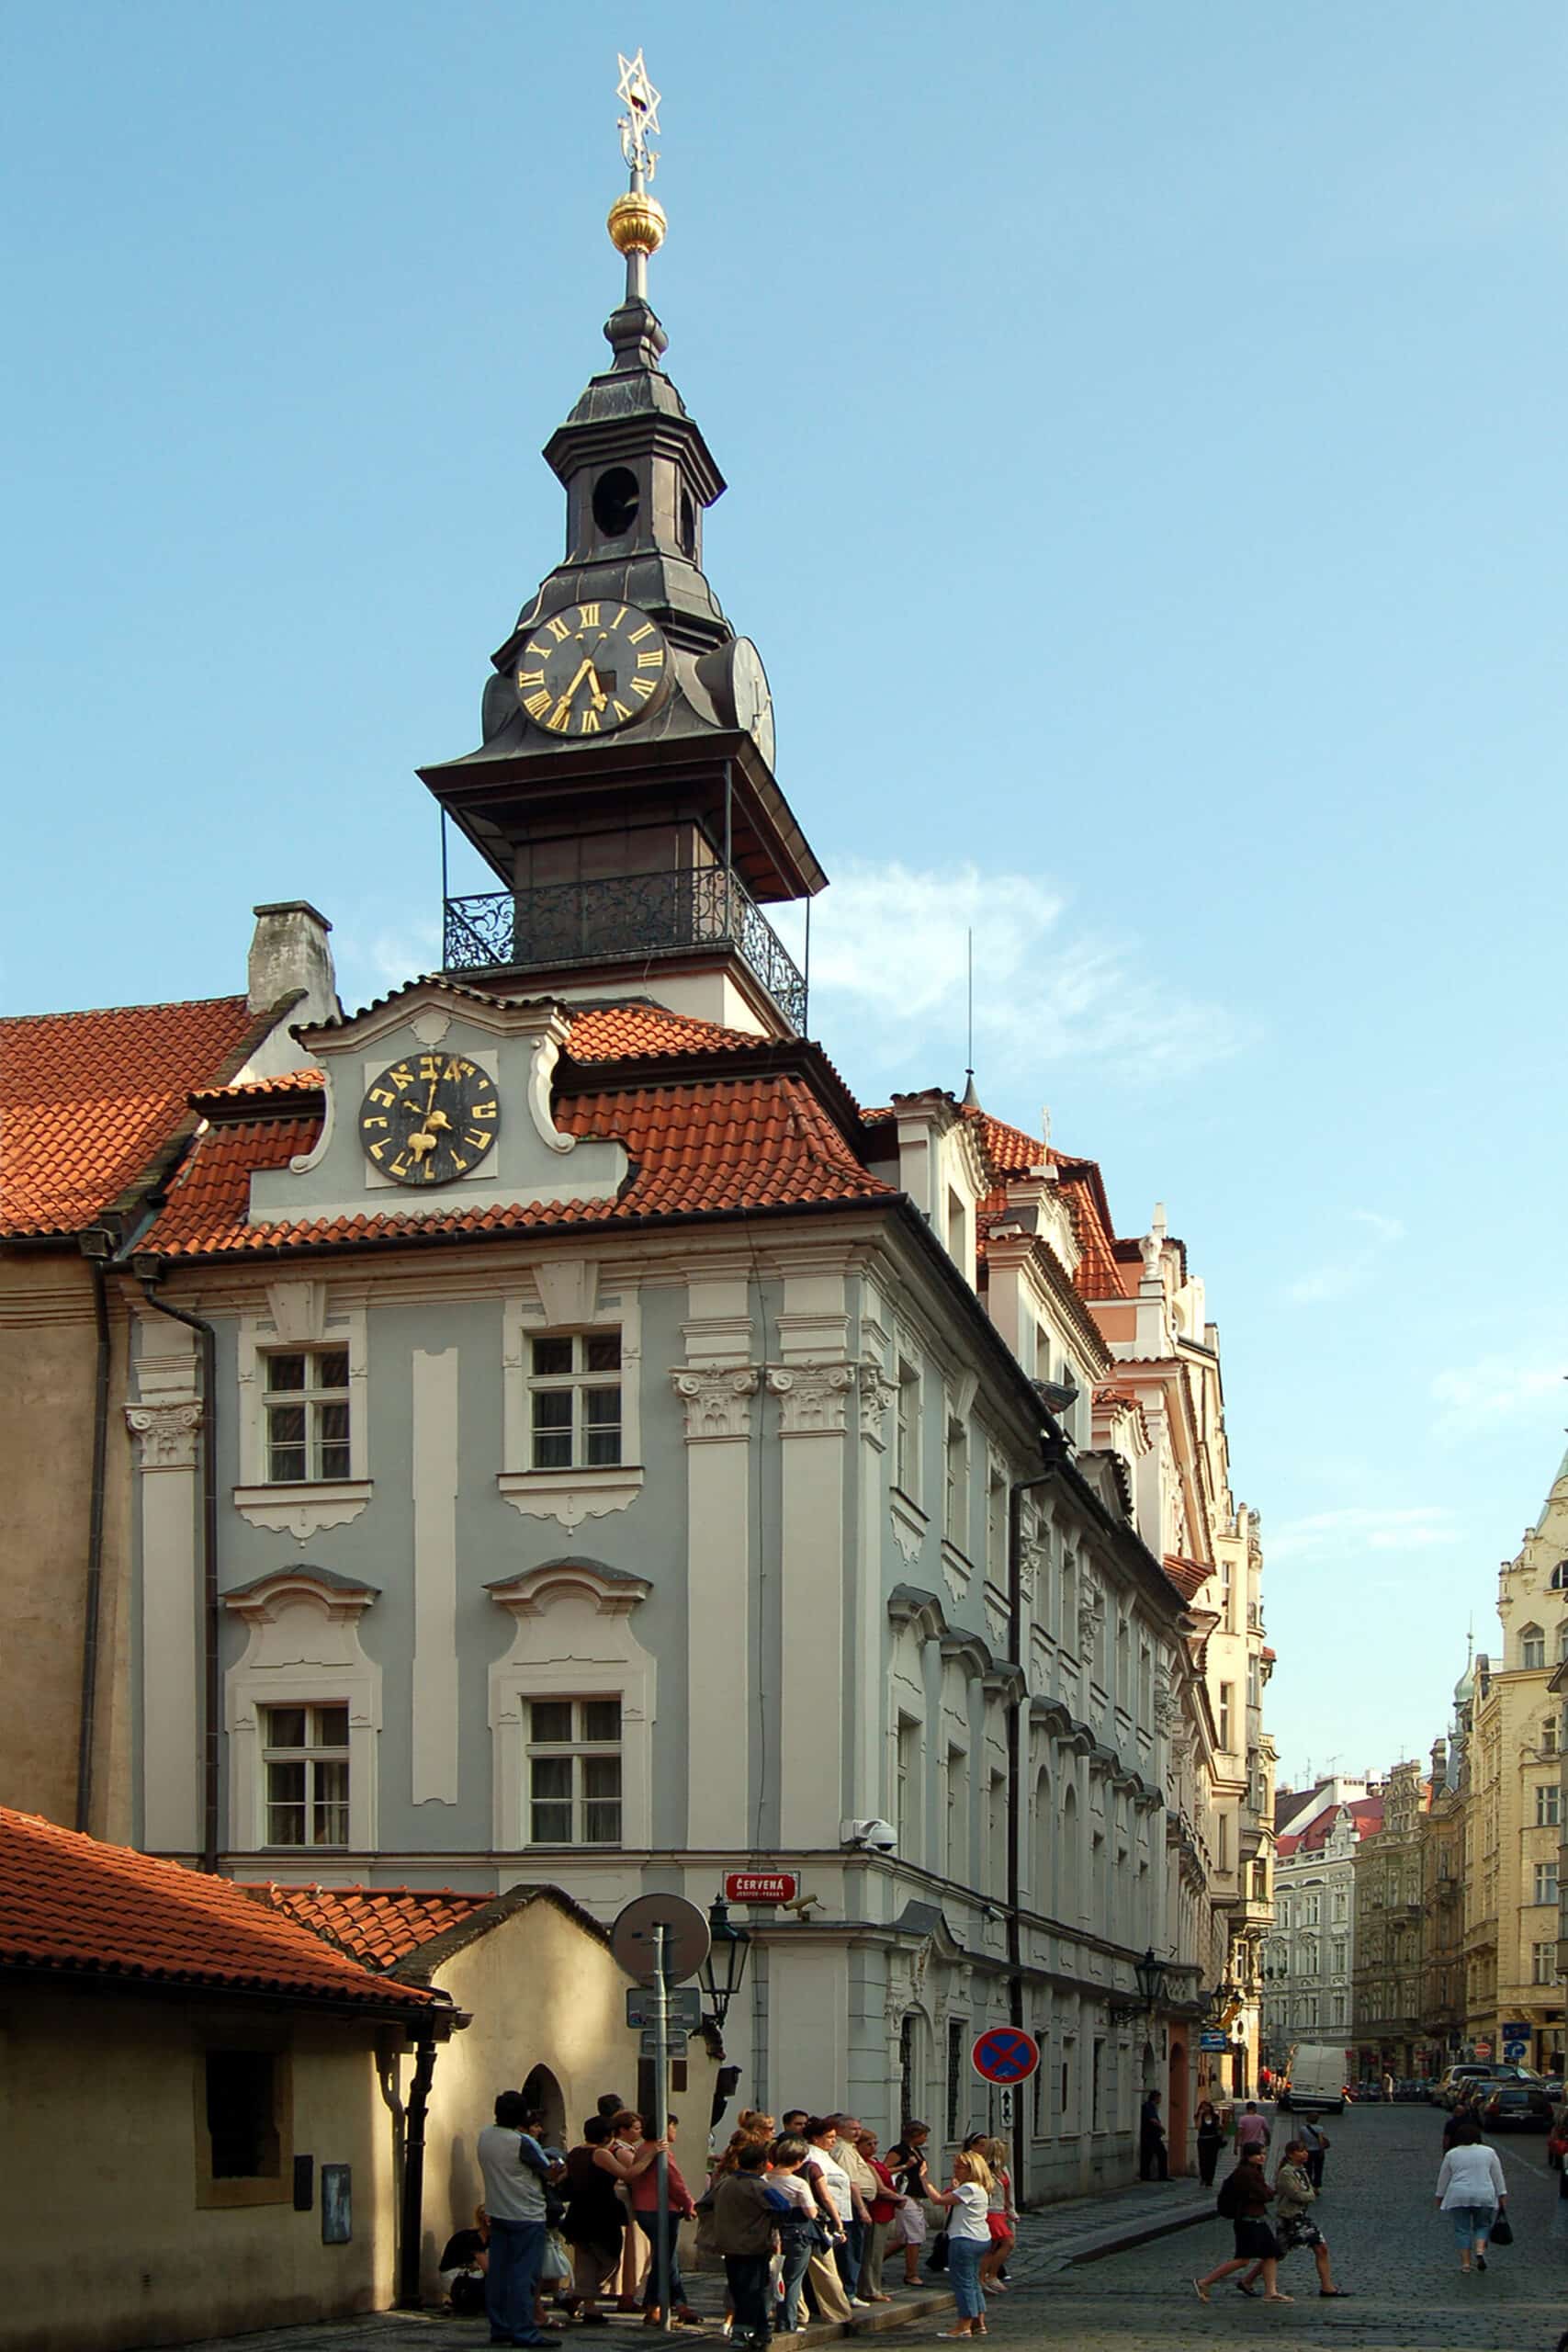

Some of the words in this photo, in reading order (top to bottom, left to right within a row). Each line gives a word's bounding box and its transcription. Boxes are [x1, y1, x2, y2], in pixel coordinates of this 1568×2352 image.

[577, 603, 601, 628] XII
[610, 606, 629, 630] I
[544, 616, 571, 643] XI
[627, 622, 655, 645] II
[525, 640, 553, 660] X
[637, 649, 663, 669] III
[518, 669, 545, 688] IX
[629, 676, 657, 699] IV
[524, 689, 553, 720] VIII
[612, 700, 633, 721] V
[581, 709, 602, 732] VI
[736, 1877, 784, 1890] ČERVENÁ
